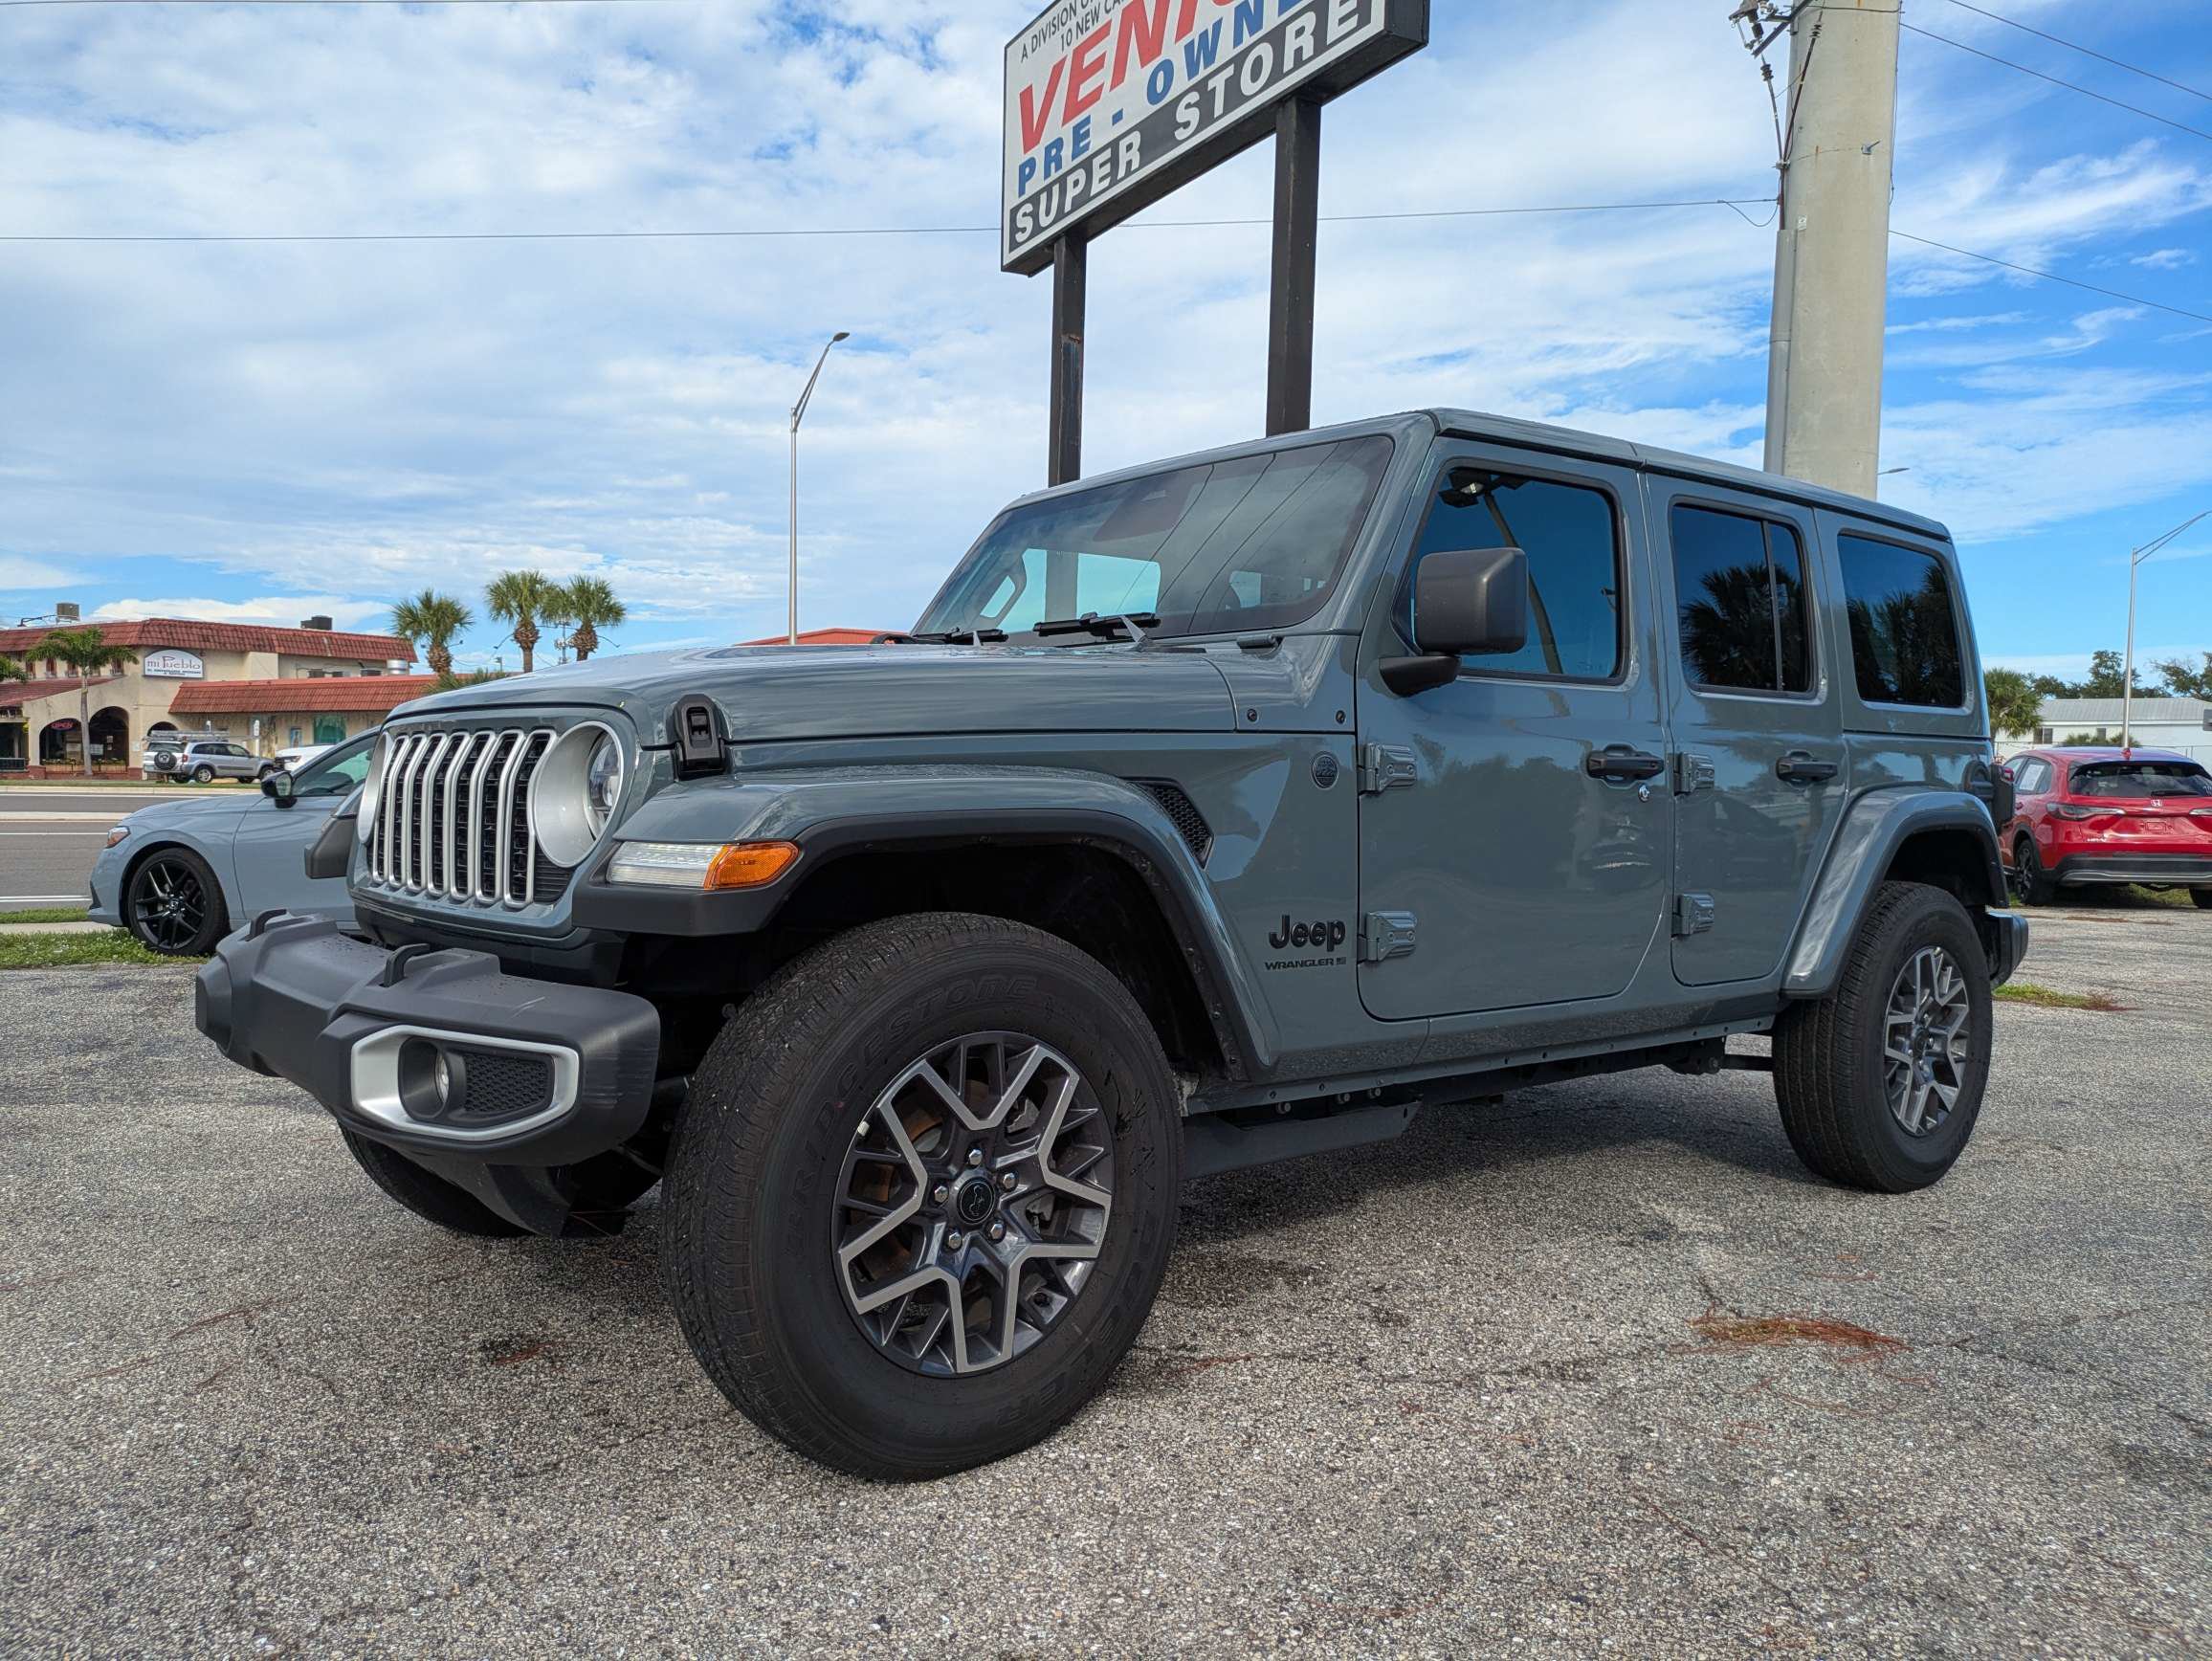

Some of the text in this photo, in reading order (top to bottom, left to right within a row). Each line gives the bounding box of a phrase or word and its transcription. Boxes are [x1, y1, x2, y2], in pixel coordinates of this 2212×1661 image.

[1021, 0, 1077, 63] A DIVISION
[1076, 2, 1101, 40] NEW
[1015, 0, 1359, 243] SUPER STORE
[1018, 115, 1091, 198] PRE
[162, 655, 201, 670] Pueblo
[1269, 915, 1346, 952] Jeep
[1265, 958, 1334, 970] WRANGLER
[783, 972, 1040, 1262] BRIDGESTONE
